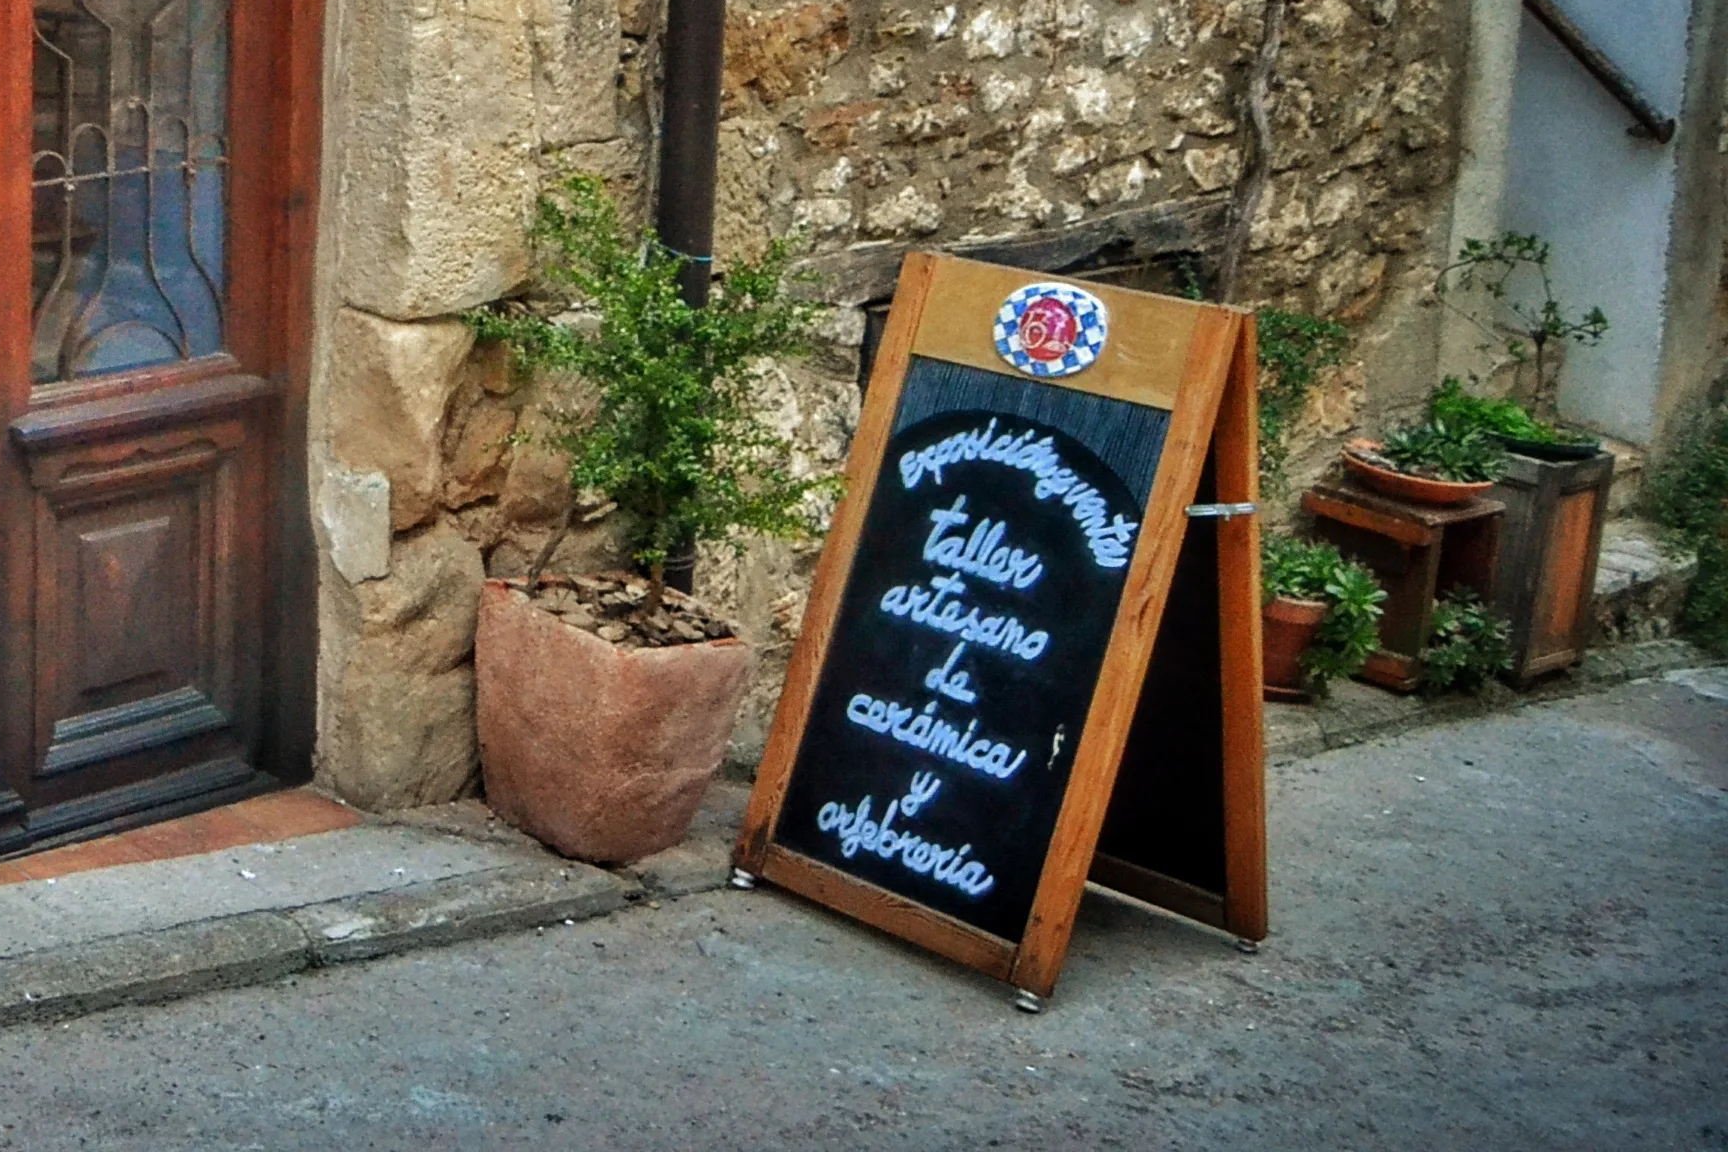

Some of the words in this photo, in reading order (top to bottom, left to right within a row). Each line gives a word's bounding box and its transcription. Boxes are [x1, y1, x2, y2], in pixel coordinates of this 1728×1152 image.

[923, 494, 1044, 589] taller
[1062, 481, 1139, 568] venta
[880, 571, 1050, 661] artesano
[925, 641, 977, 704] de
[847, 693, 1027, 779] cerámica
[900, 770, 942, 817] y
